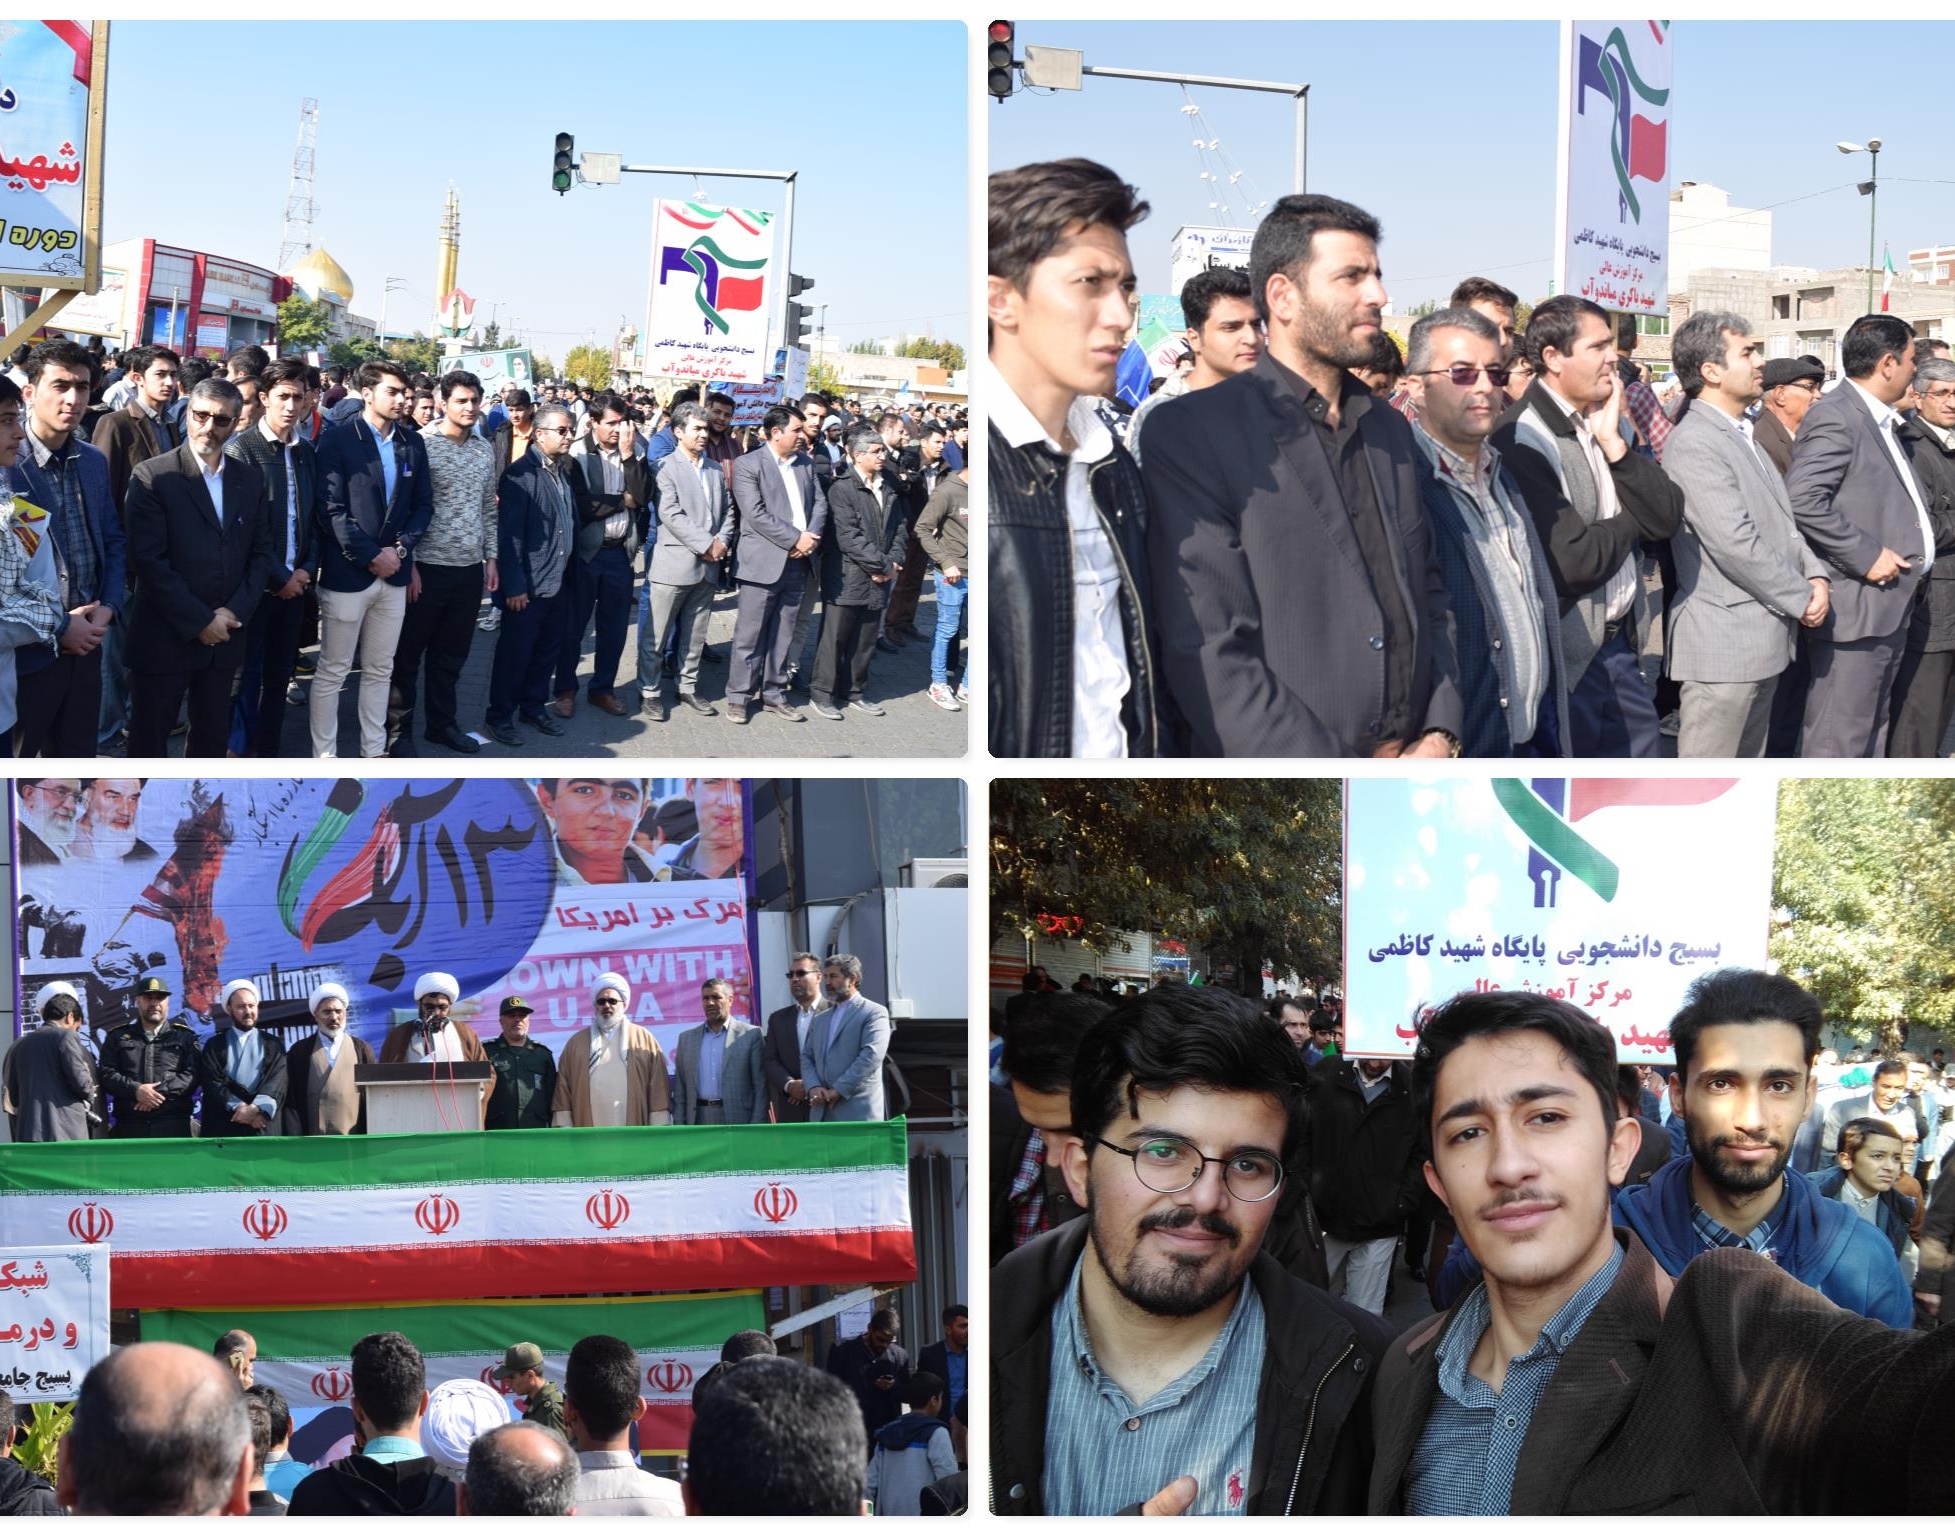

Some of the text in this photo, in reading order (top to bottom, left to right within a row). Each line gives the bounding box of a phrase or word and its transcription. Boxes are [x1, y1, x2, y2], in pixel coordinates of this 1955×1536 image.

[9, 226, 77, 252] دوره
[1574, 228, 1594, 244] کاظمی
[1595, 234, 1608, 249] شهید
[1600, 260, 1612, 275] عالی
[1619, 287, 1639, 308] باکری
[1640, 291, 1655, 309] شهید
[702, 367, 725, 379] باکری
[728, 370, 747, 379] شهید
[650, 906, 675, 929] بر
[1368, 932, 1722, 966] بسیج دانشجویی پایگاه شهید کاظمی
[623, 950, 734, 985] WITH
[1584, 980, 1632, 1007] مرکز
[1621, 1024, 1675, 1054] هید
[62, 1322, 77, 1347] و
[36, 1370, 71, 1390] بسیج
